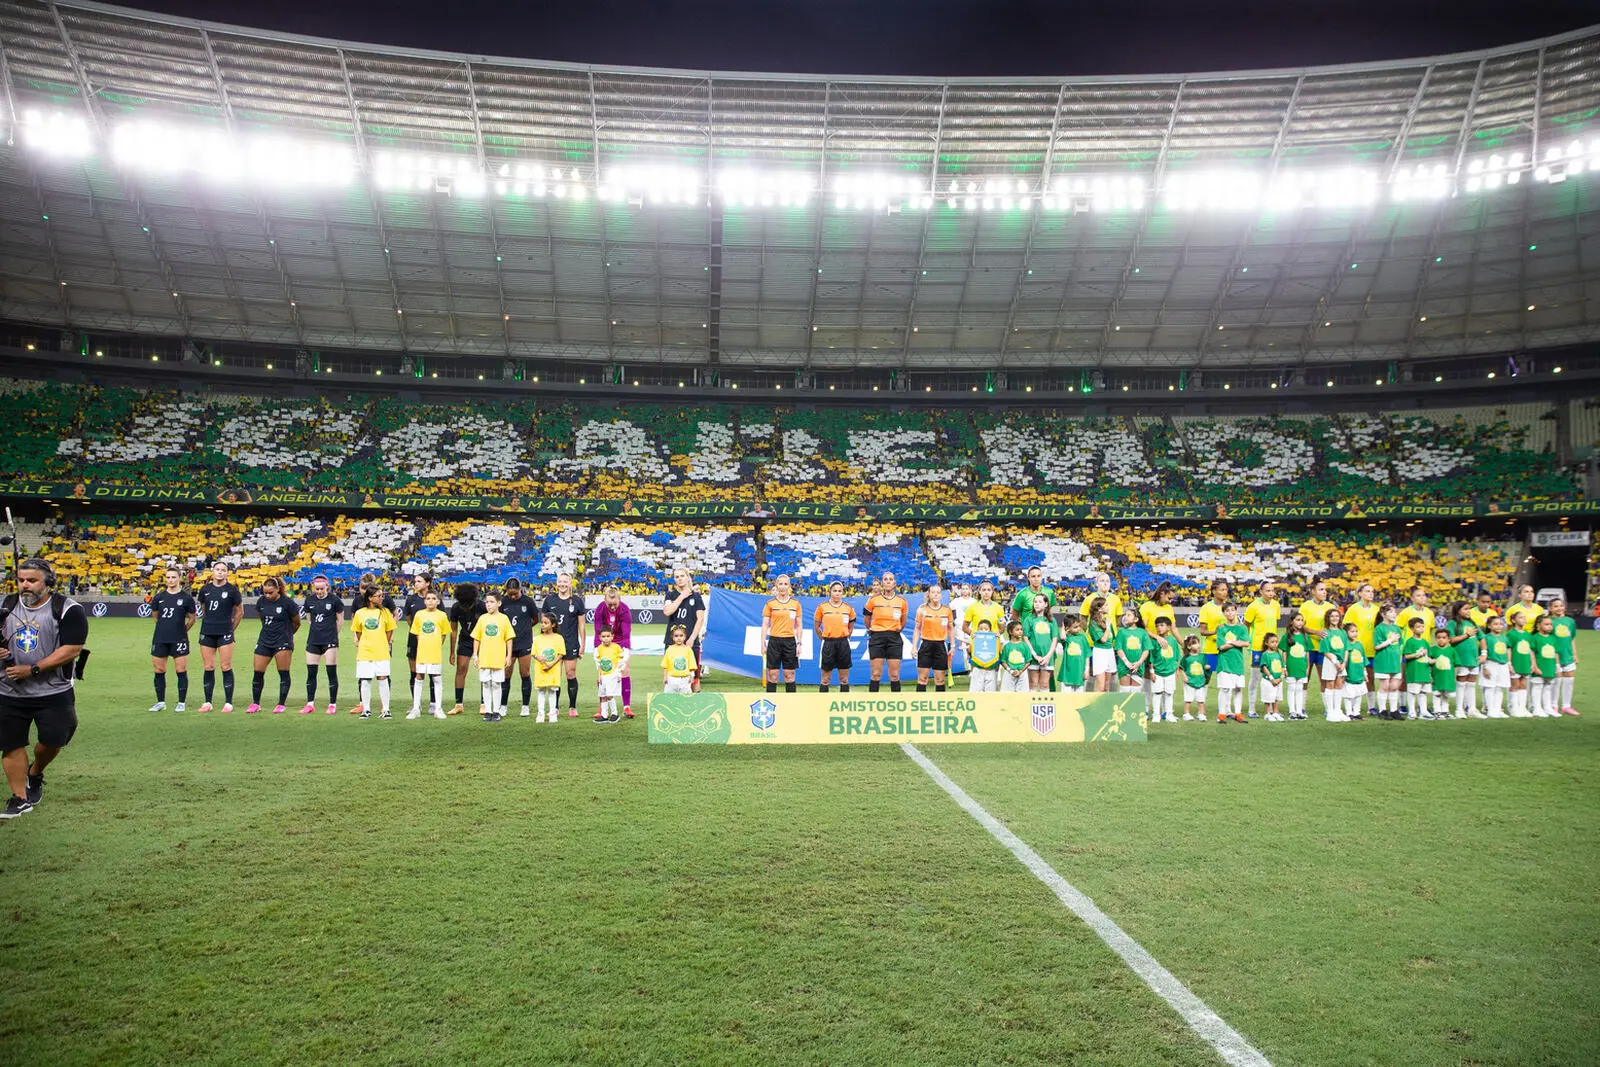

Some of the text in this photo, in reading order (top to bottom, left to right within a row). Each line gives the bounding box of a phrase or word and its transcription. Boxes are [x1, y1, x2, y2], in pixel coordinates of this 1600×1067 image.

[95, 487, 206, 500] DUDINHA
[256, 493, 347, 505] ANGELINA
[384, 497, 482, 508] GUTIERRES
[527, 500, 608, 512] MARTA
[642, 504, 736, 515] KEROLIN
[782, 506, 842, 517] LELÊ
[888, 507, 947, 517] YAYA
[983, 507, 1076, 517] LUDMILA
[1228, 507, 1333, 516] ZANERATTO
[1364, 505, 1474, 516] ARY BORGES
[1510, 504, 1529, 514] G.
[208, 600, 219, 611] 19
[162, 607, 174, 618] 23
[676, 607, 687, 619] 10
[511, 615, 518, 627] 6
[558, 614, 564, 624] 3
[829, 698, 976, 714] AMISTOSO SELEÇÃO
[1032, 707, 1055, 718] USA
[829, 716, 978, 735] BRASILEIRA
